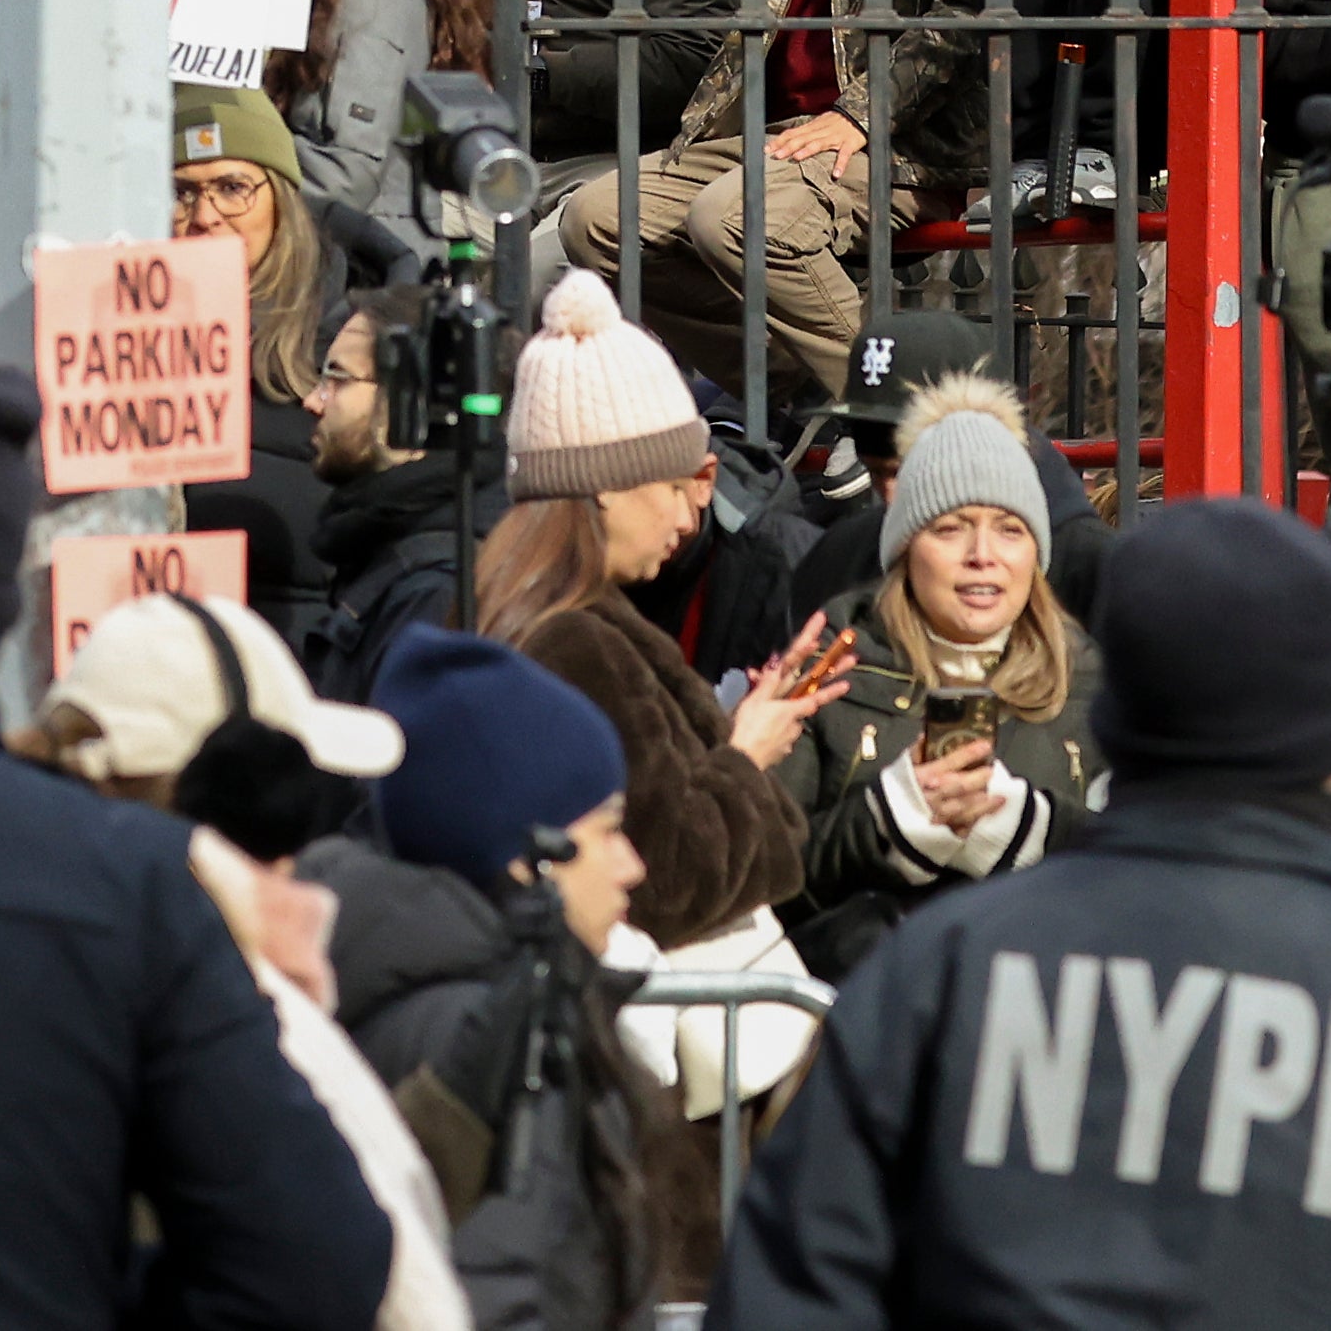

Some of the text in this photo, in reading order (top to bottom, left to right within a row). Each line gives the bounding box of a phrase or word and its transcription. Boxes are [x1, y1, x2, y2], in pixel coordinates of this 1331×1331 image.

[170, 40, 257, 89] ZUELA!
[117, 258, 171, 312] NO
[56, 322, 229, 386] PARKING
[61, 391, 229, 456] MONDAY
[133, 546, 185, 598] NO
